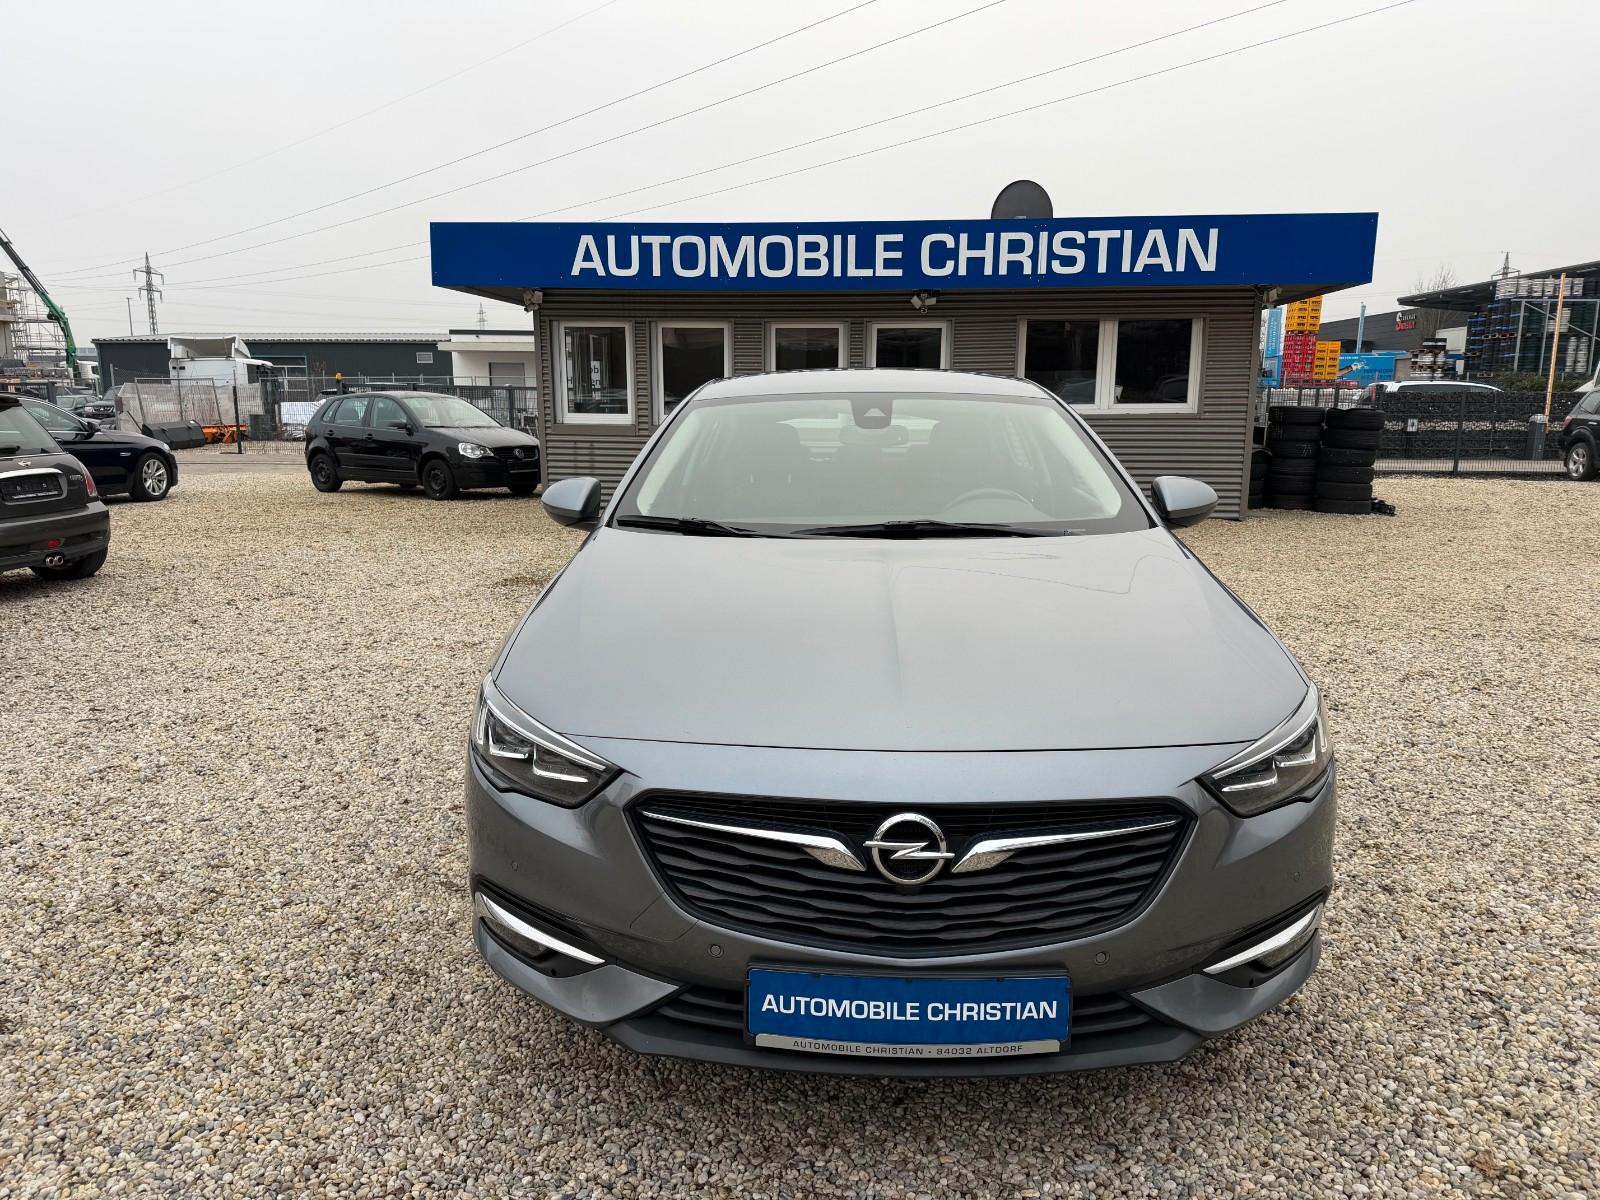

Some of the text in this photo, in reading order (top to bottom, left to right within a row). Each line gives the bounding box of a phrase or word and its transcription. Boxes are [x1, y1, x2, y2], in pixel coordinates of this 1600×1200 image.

[570, 227, 1219, 279] AUTOMOBILE CHRISTIAN
[761, 993, 1057, 1021] AUTOMOBILE CHRISTIAN
[792, 1040, 1023, 1056] AUTOMOBILE CHRISTIAN 84032 ALTDORF
